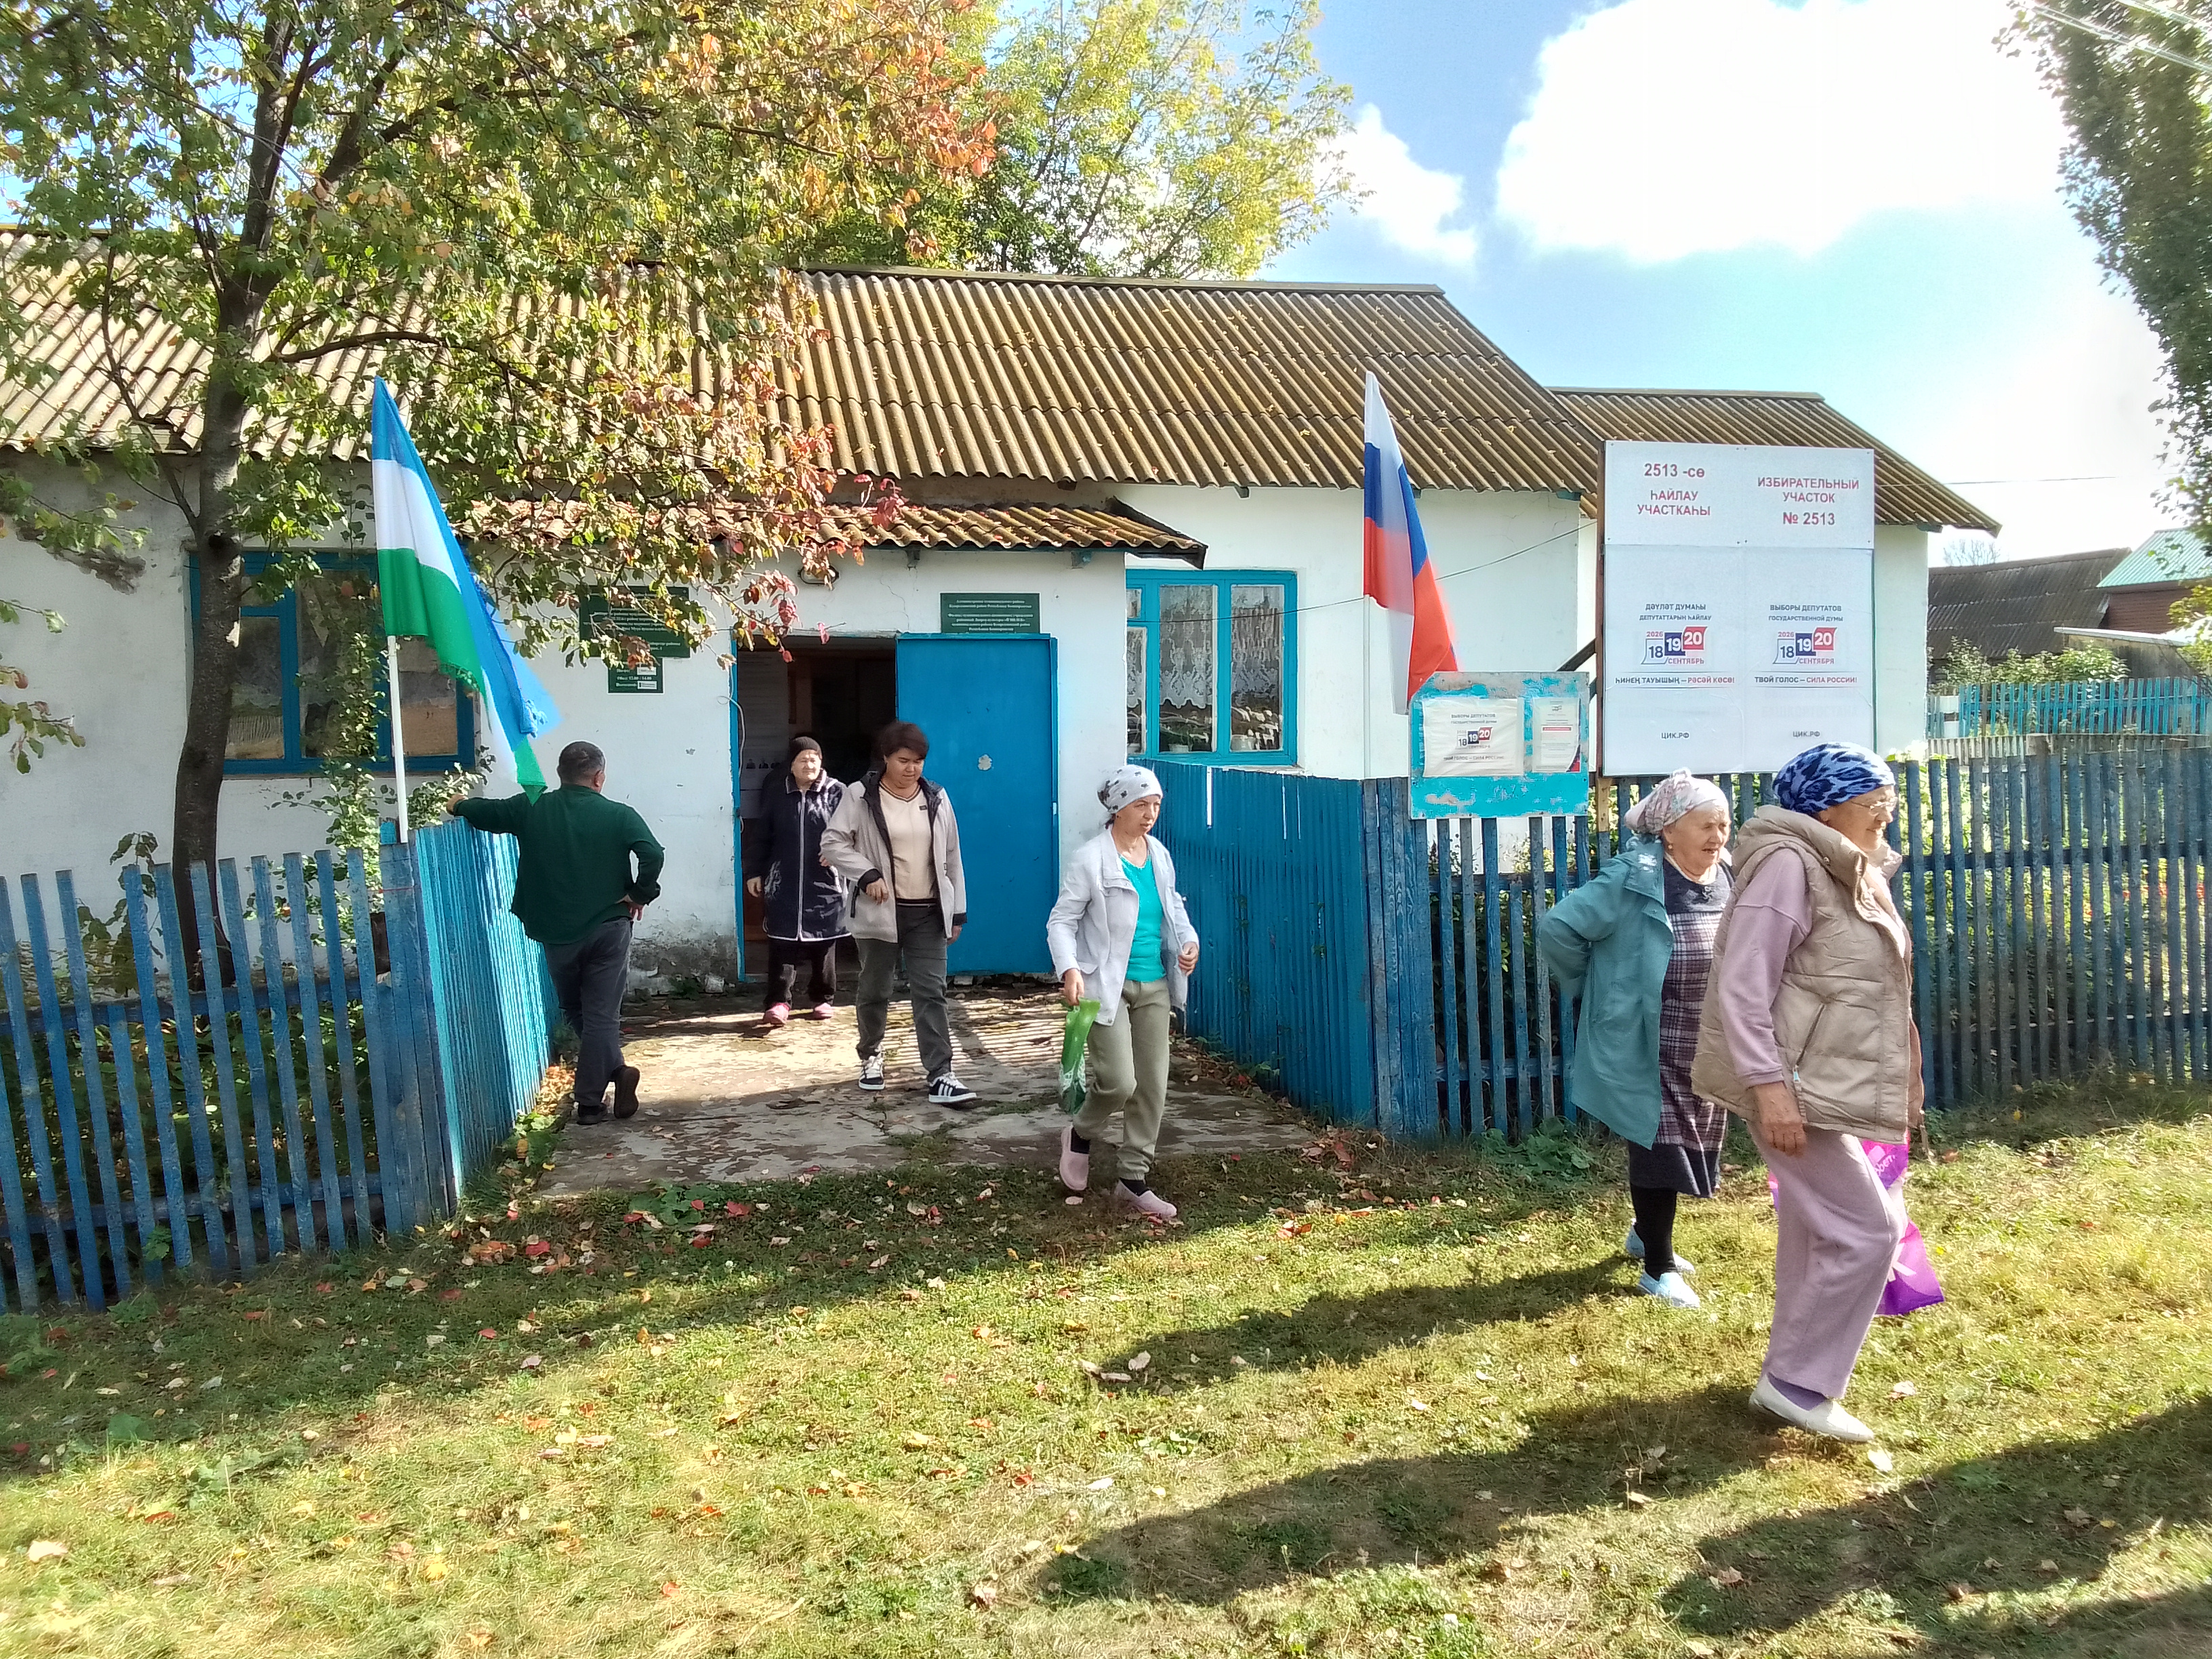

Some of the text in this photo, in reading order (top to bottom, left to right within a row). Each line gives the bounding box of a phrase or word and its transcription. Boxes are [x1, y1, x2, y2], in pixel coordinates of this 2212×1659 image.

[1644, 463, 1678, 477] 2513
[1757, 476, 1860, 489] ИЗБИРАТЕЛЬНЫЙ
[1782, 491, 1835, 503] УЧАСТОК
[1782, 512, 1835, 525] № 2513
[1648, 631, 1702, 659] 18 19 20
[1780, 632, 1832, 659] 18 19 20
[1755, 675, 1774, 683] ТВОЙ
[1458, 729, 1490, 747] 18 19 20
